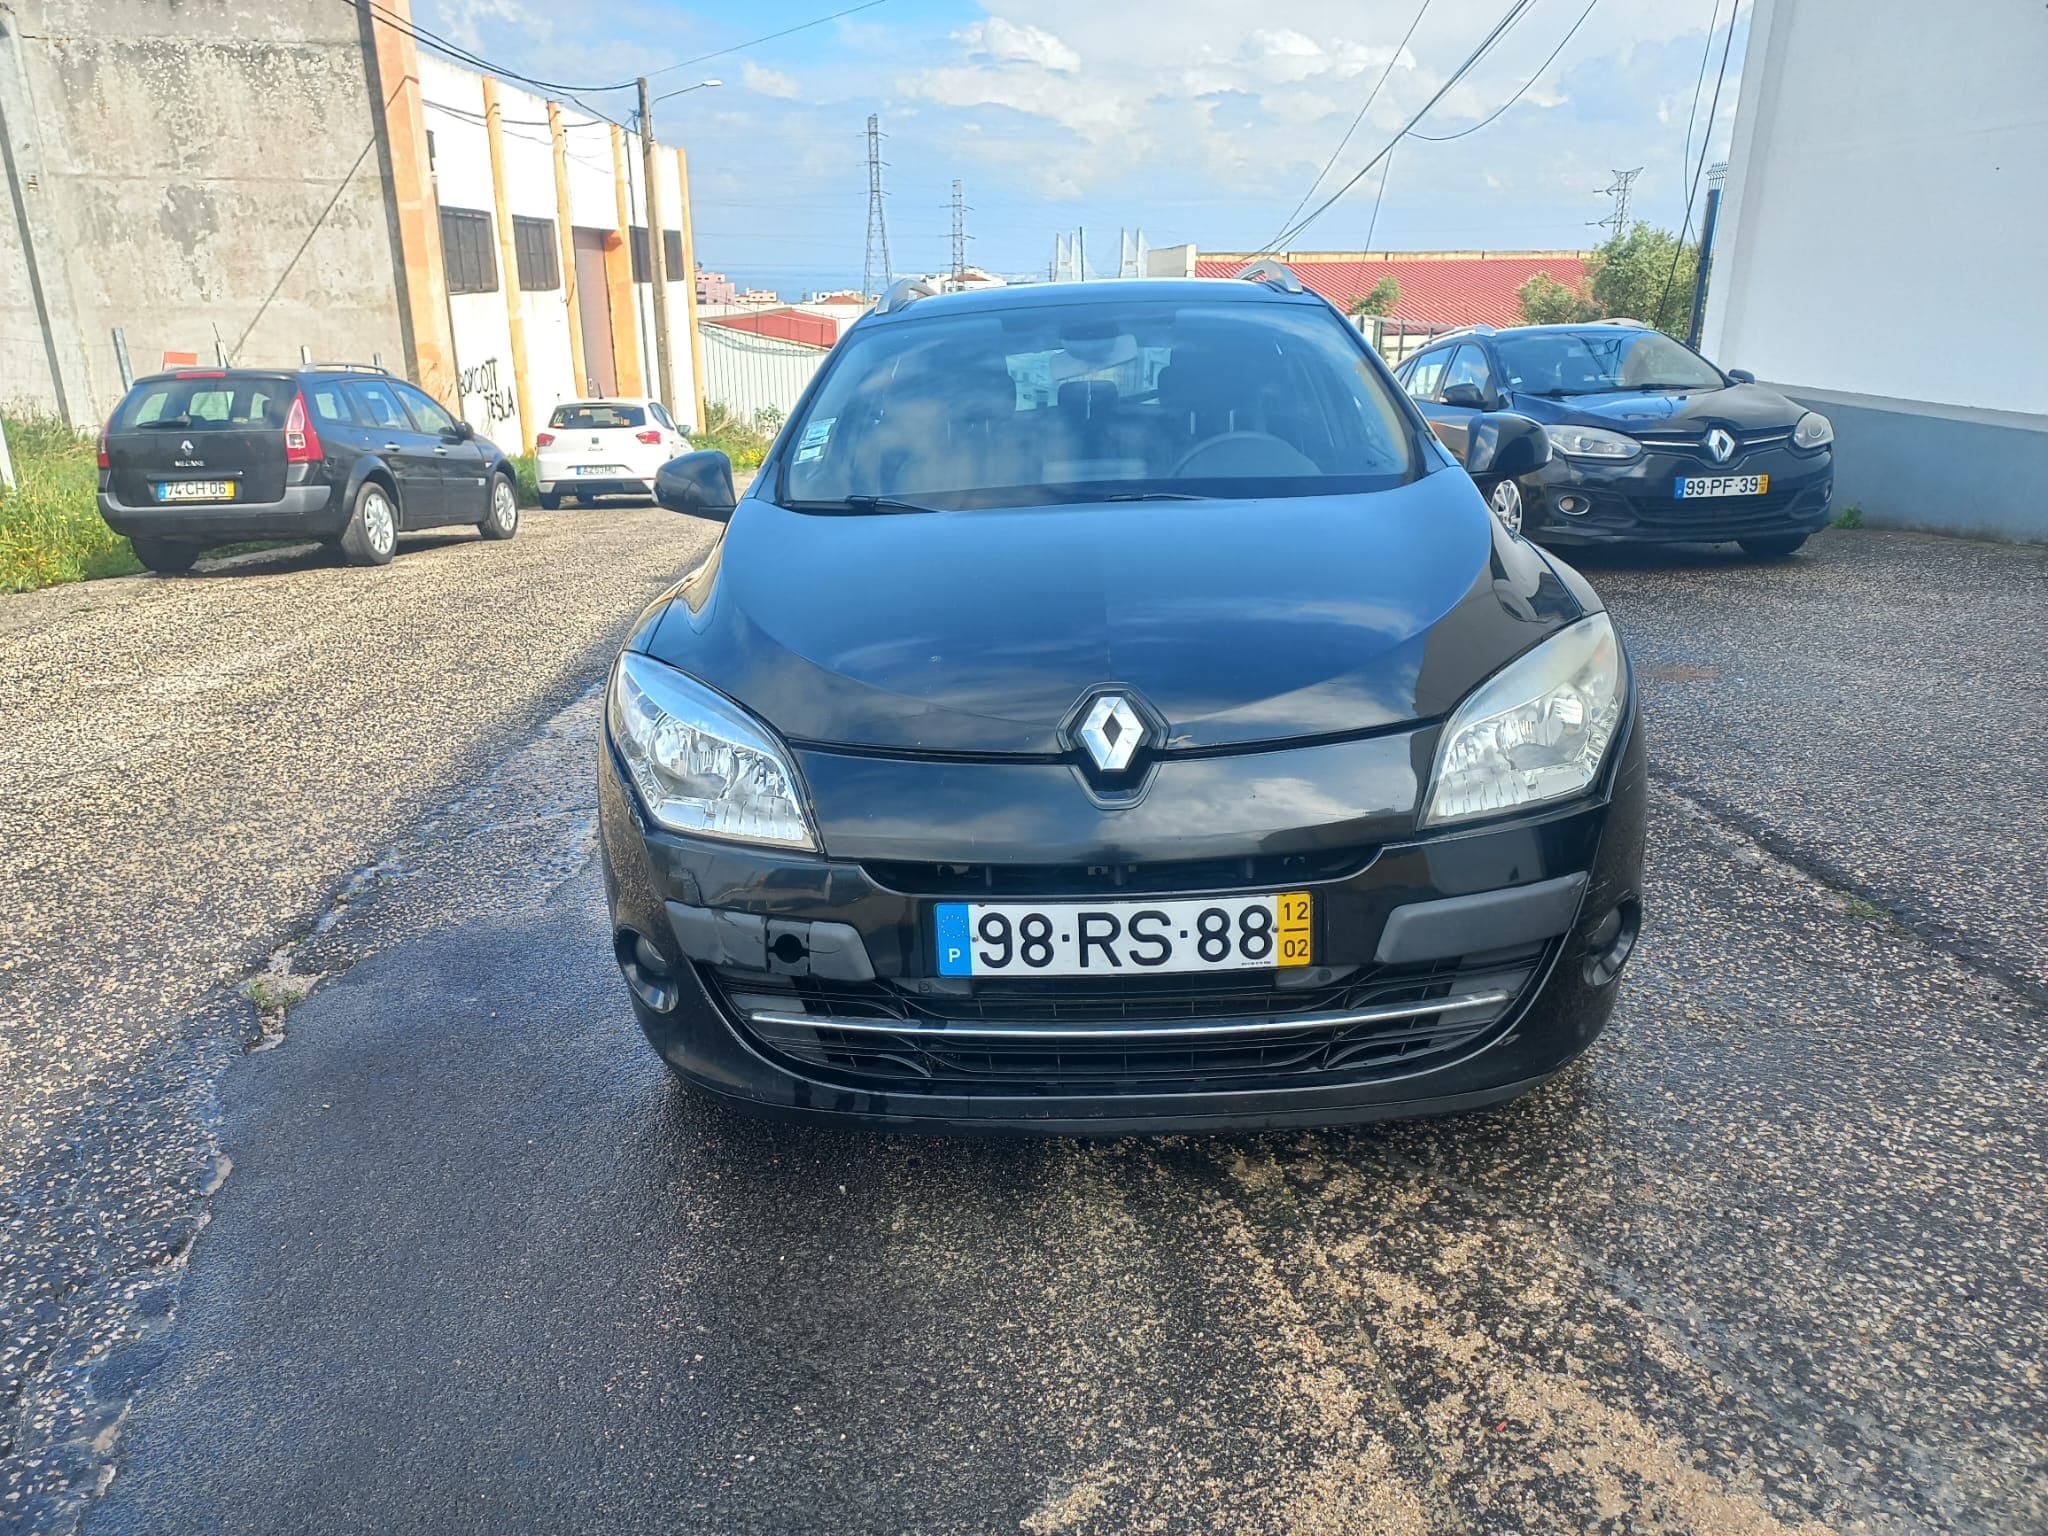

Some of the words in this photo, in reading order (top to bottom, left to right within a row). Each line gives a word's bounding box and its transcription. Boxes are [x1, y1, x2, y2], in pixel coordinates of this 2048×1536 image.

[459, 358, 498, 398] BOYCOTT
[484, 386, 515, 422] TESLA
[1283, 902, 1309, 921] 12
[948, 948, 961, 963] P
[1284, 939, 1309, 958] 02
